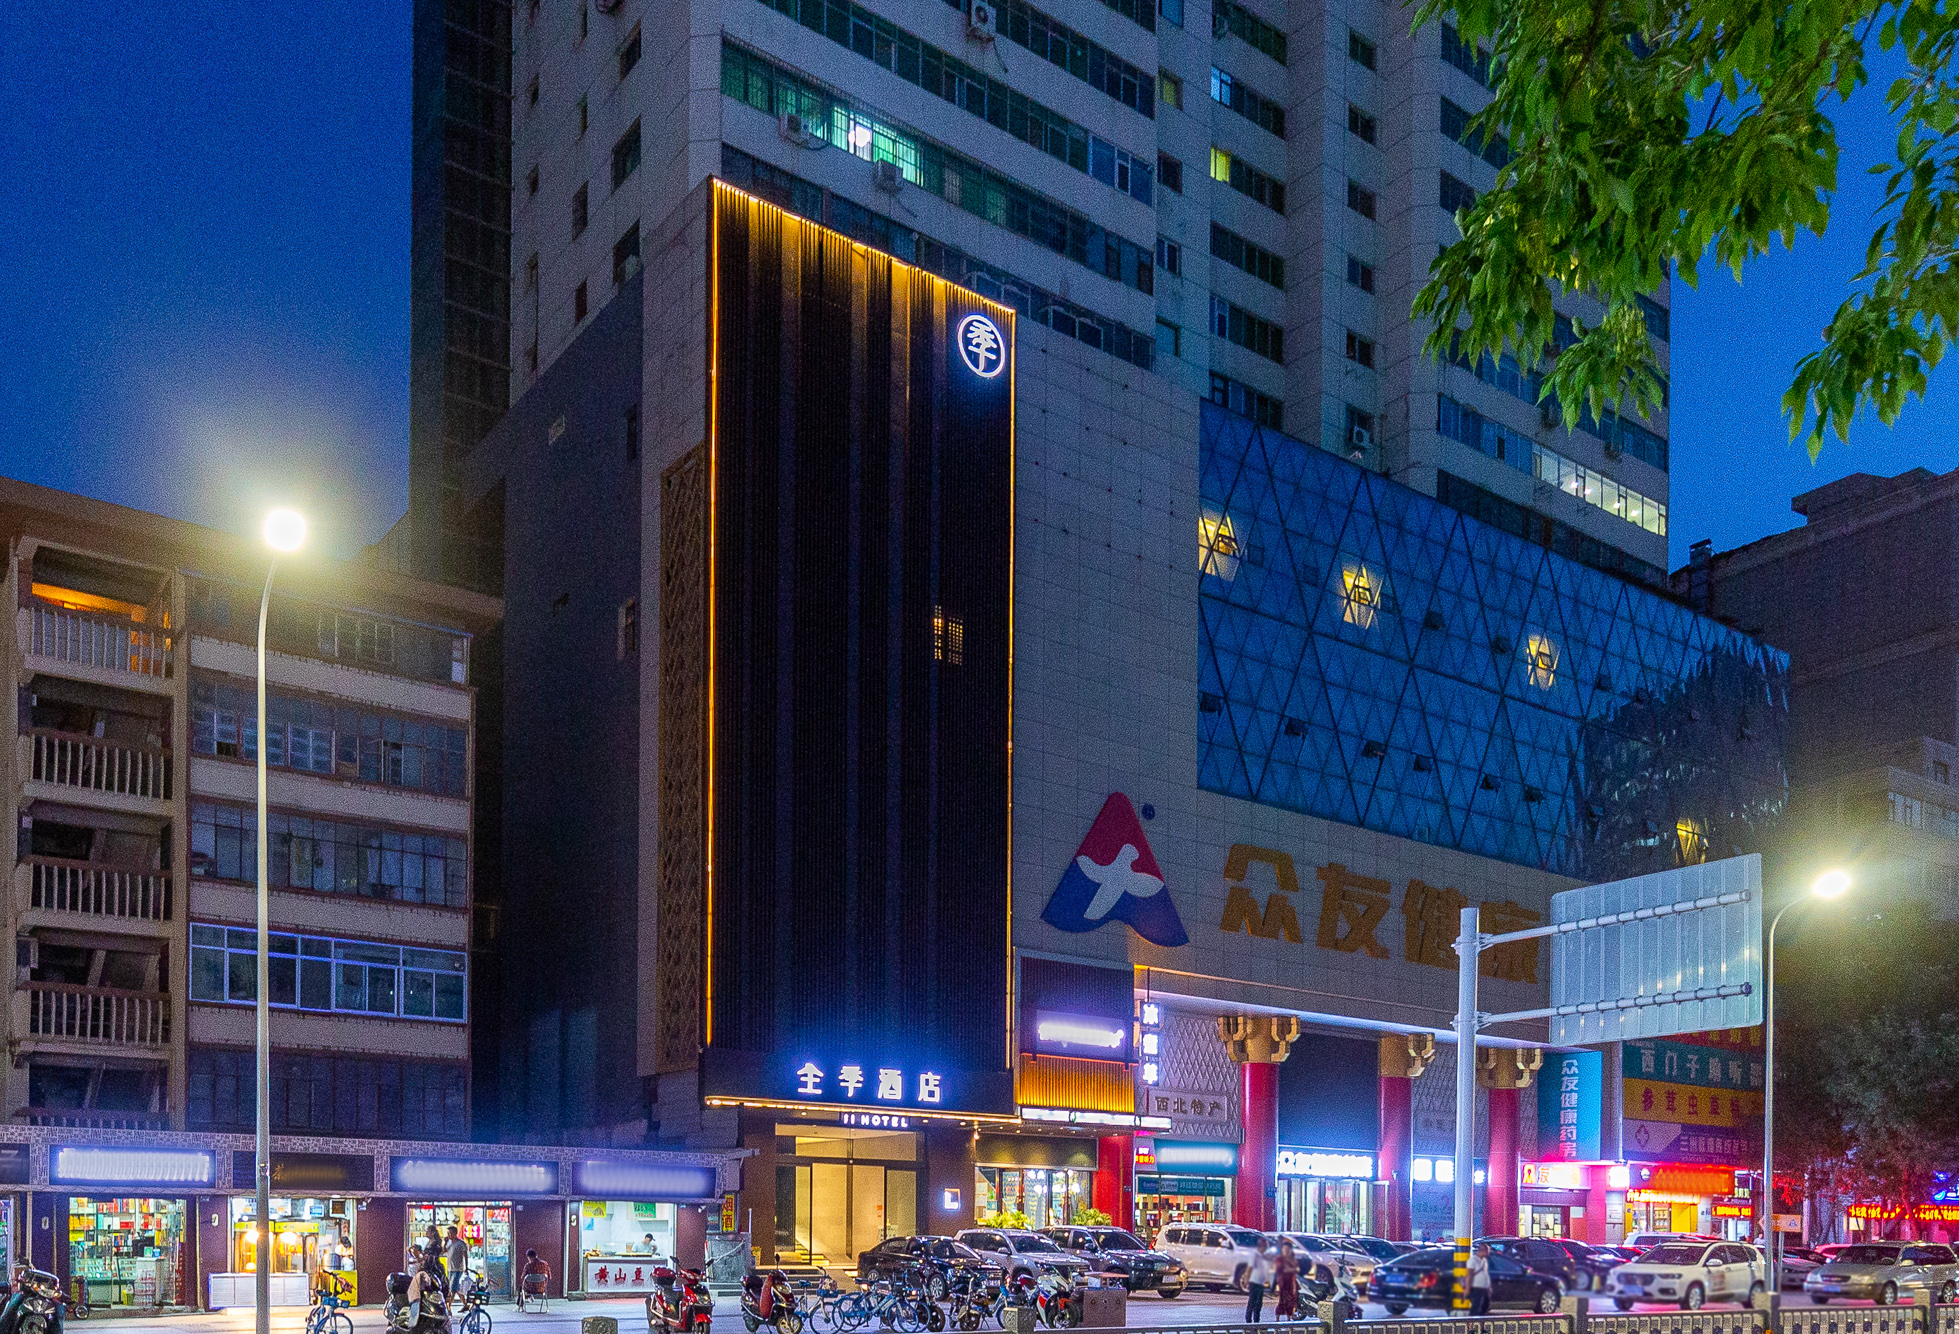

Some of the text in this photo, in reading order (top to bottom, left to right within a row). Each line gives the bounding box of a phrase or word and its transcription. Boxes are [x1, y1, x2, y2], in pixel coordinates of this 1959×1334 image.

[1219, 844, 1541, 985] 众友健康
[797, 1063, 941, 1102] 全季酒店
[861, 1114, 909, 1128] HOTEL
[1154, 1096, 1222, 1116] 西北特产
[1560, 1059, 1579, 1158] 众友健康药房
[722, 1197, 734, 1228] 烟酒
[594, 1264, 645, 1283] 黄山豆
